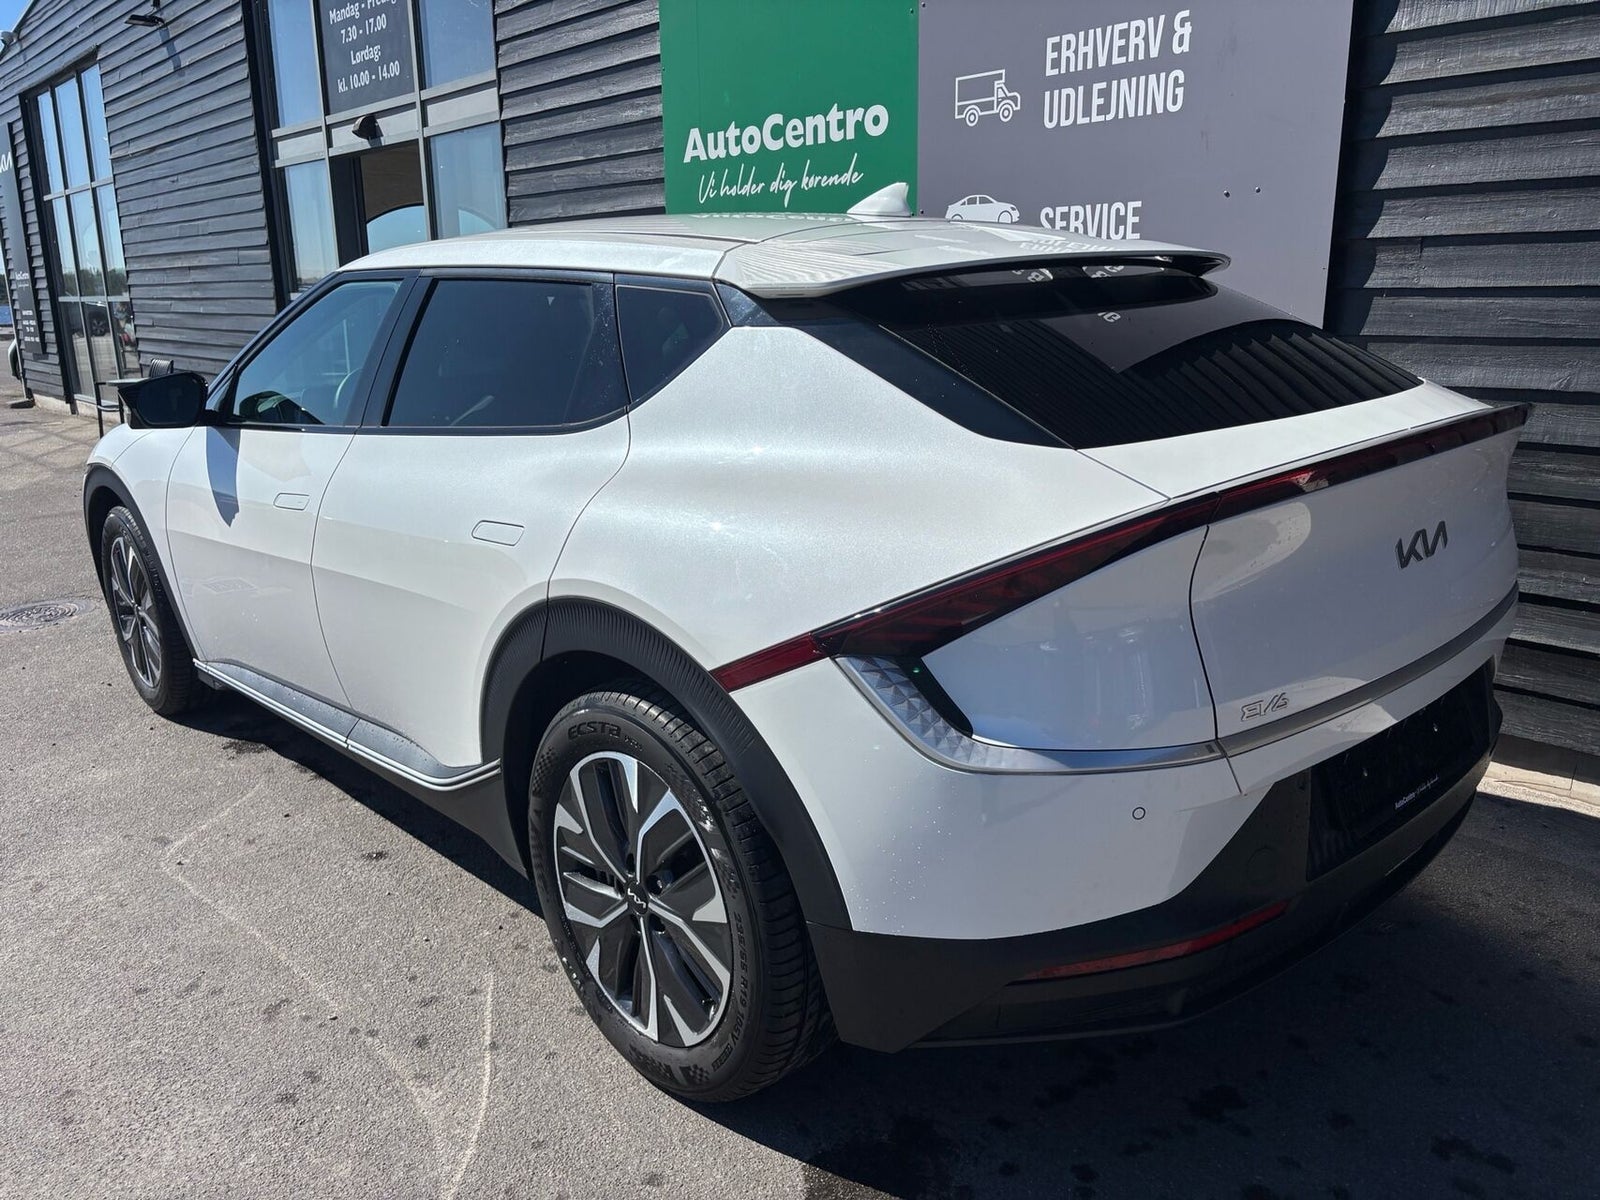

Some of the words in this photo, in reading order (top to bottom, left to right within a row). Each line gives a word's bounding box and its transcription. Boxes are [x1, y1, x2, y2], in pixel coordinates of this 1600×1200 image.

[329, 2, 359, 25] Mandag
[340, 25, 357, 44] 7.30
[365, 13, 387, 35] 17.00
[350, 44, 381, 65] Lørdag:
[1045, 14, 1166, 77] ERHVERV
[1172, 9, 1192, 55] &
[337, 77, 348, 93] kl.
[350, 70, 370, 89] 10.00
[378, 60, 400, 81] 14.00
[1043, 69, 1185, 129] UDLEJNING
[683, 103, 889, 163] AutoCentro
[699, 170, 717, 204] Vi
[720, 163, 765, 197] holder
[769, 162, 798, 208] dig
[1040, 200, 1142, 240] SERVICE
[1241, 692, 1289, 721] EV6
